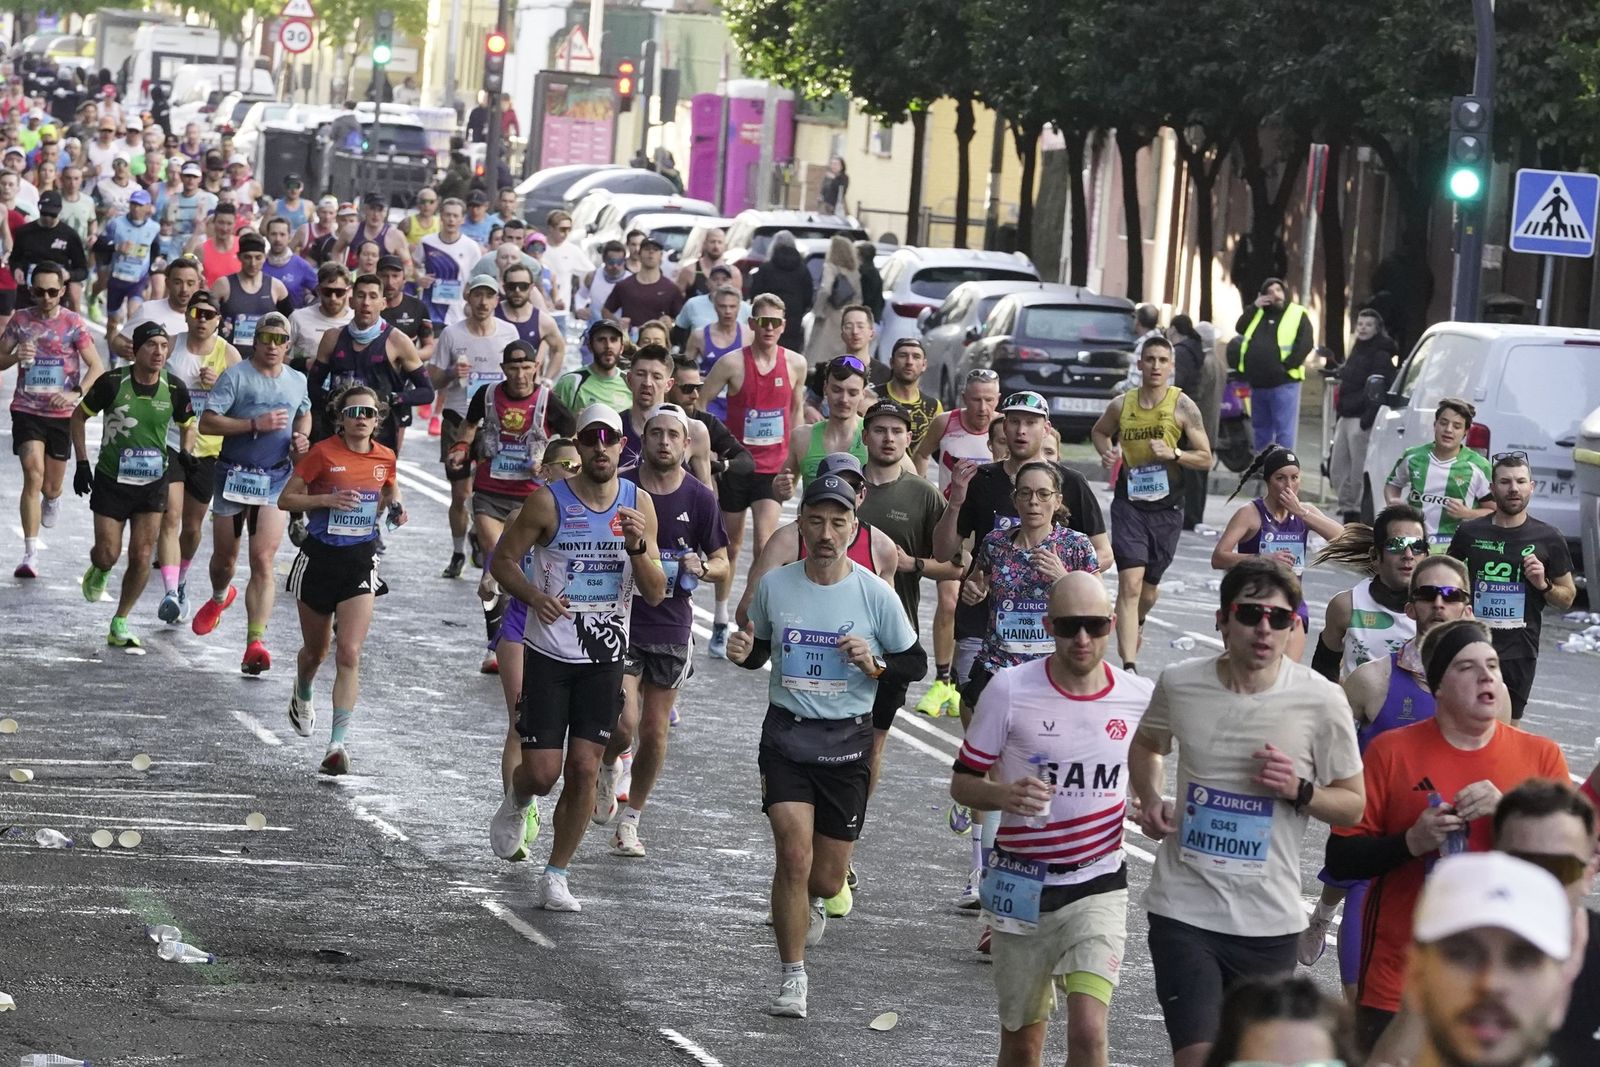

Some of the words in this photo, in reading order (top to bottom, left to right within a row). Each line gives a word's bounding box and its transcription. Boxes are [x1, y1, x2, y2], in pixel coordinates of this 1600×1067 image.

[287, 30, 307, 42] 30
[32, 376, 57, 385] SIMON
[124, 468, 159, 477] MICHELE
[229, 482, 266, 496] THIBAULT
[558, 542, 591, 551] MONTI
[588, 563, 618, 571] ZURICH
[1490, 584, 1519, 592] ZURICH
[1482, 606, 1515, 617] BASILE
[806, 652, 823, 661] 7111
[806, 664, 822, 677] JO
[1212, 795, 1262, 812] ZURICH
[1211, 819, 1237, 833] 6343
[1186, 829, 1262, 856] ANTHONY
[1000, 858, 1039, 876] ZURICH
[992, 894, 1013, 914] FLO
